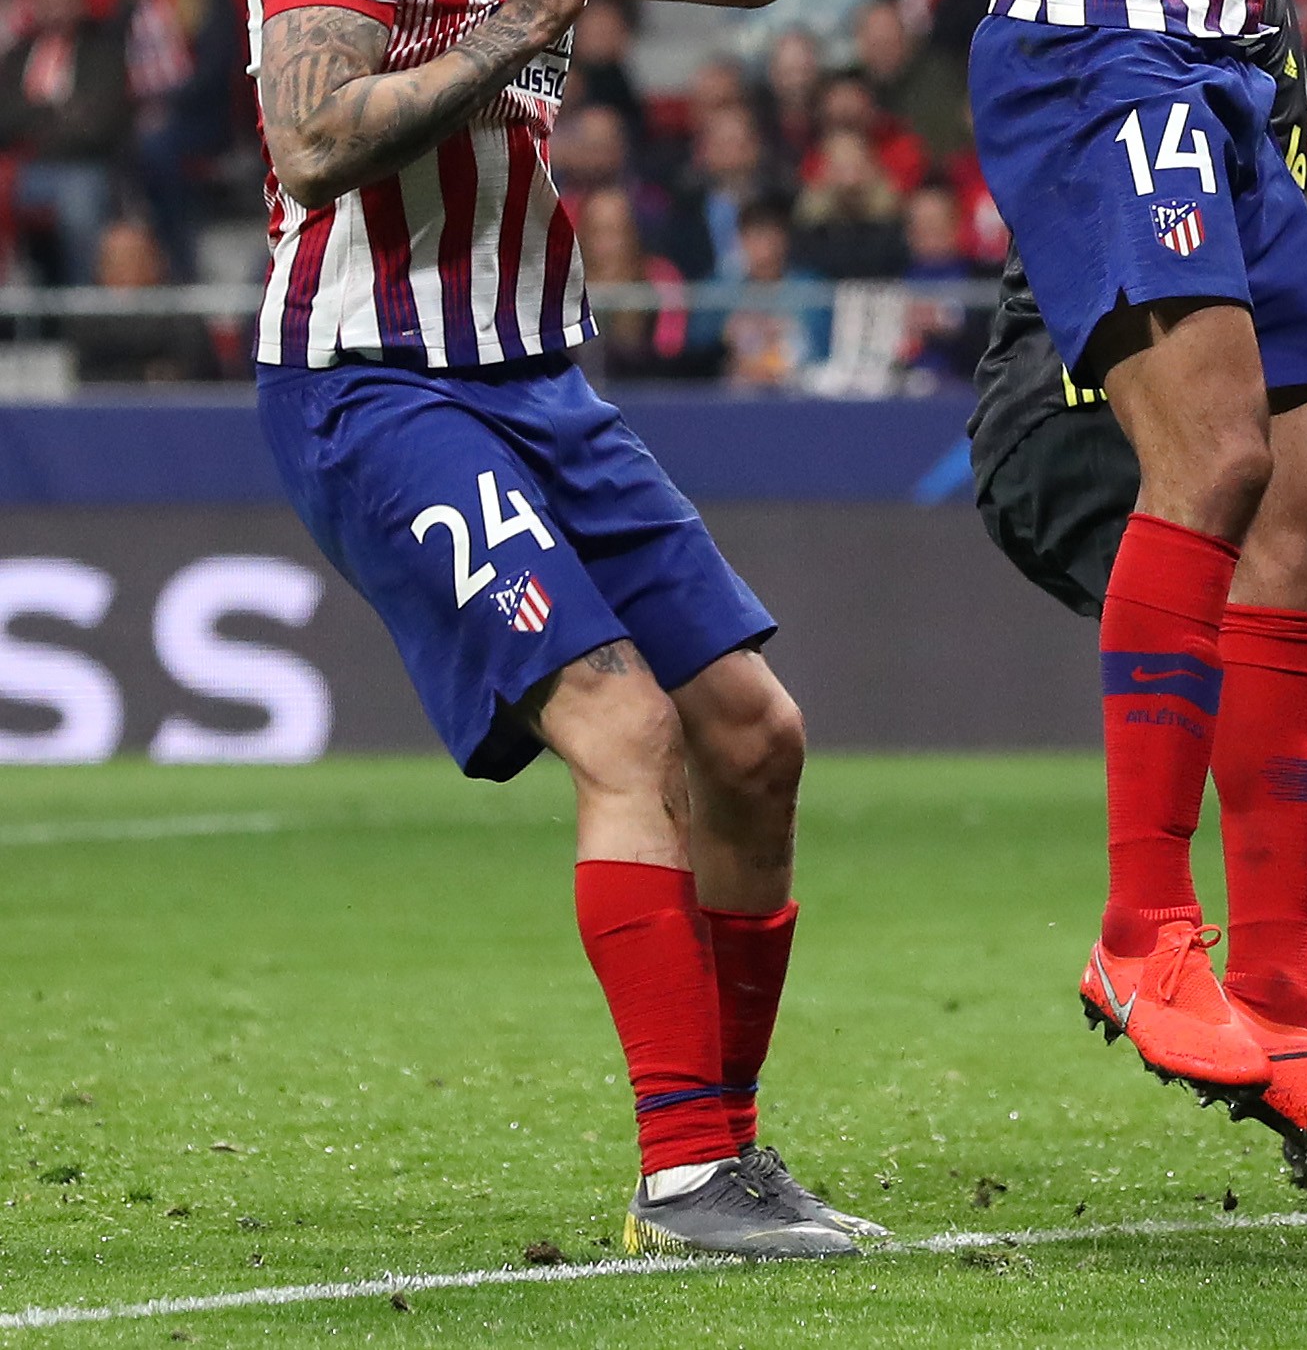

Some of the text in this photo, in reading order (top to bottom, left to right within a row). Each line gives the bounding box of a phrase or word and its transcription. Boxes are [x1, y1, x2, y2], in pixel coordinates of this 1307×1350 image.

[1114, 102, 1217, 196] 14
[410, 471, 556, 610] 24
[0, 554, 332, 766] ss
